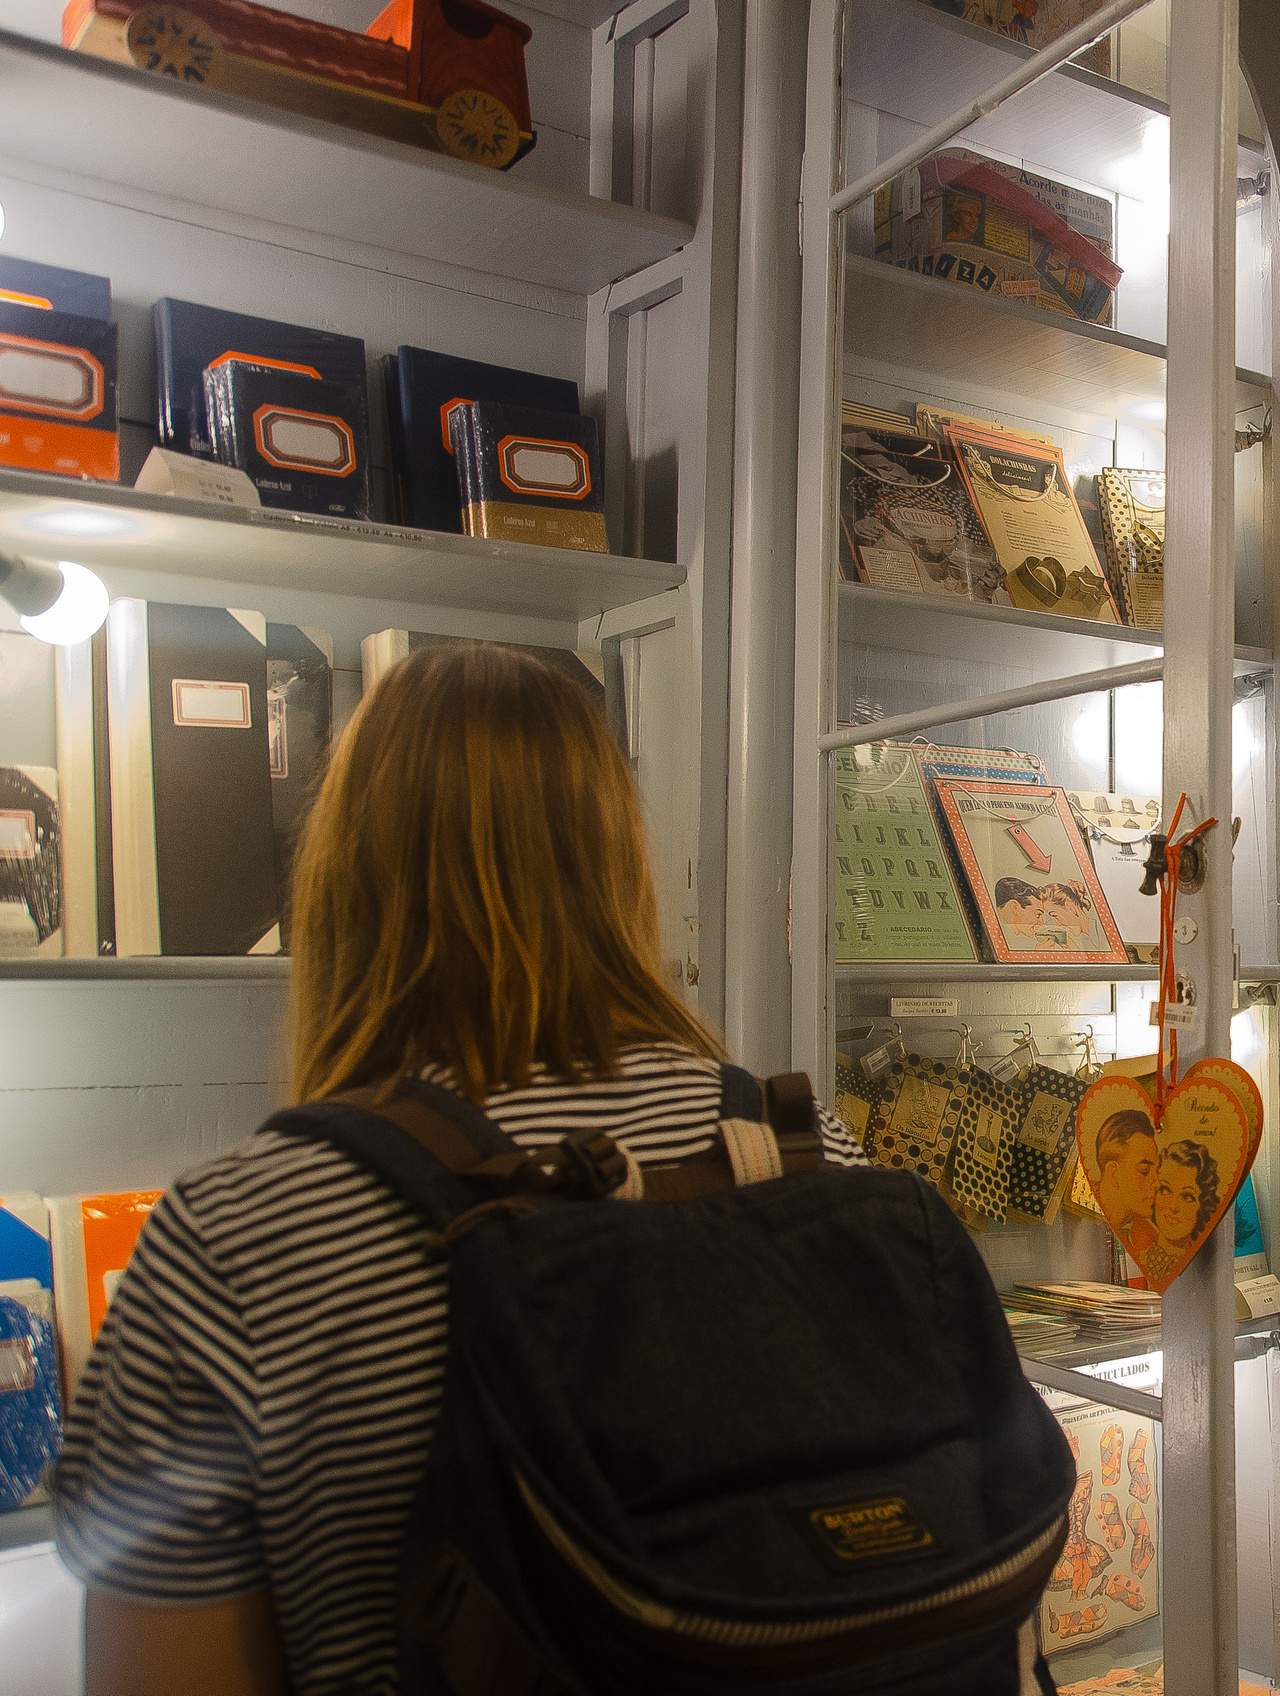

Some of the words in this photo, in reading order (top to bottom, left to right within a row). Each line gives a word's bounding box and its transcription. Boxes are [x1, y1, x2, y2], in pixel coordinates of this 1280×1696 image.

[1019, 171, 1058, 195] Acorde
[1061, 186, 1084, 203] mais
[1055, 202, 1066, 212] as
[989, 455, 1037, 473] BOLACHINHAS
[1182, 925, 1187, 936] 3
[896, 1123, 904, 1132] Os
[905, 1126, 930, 1140] biscoitos
